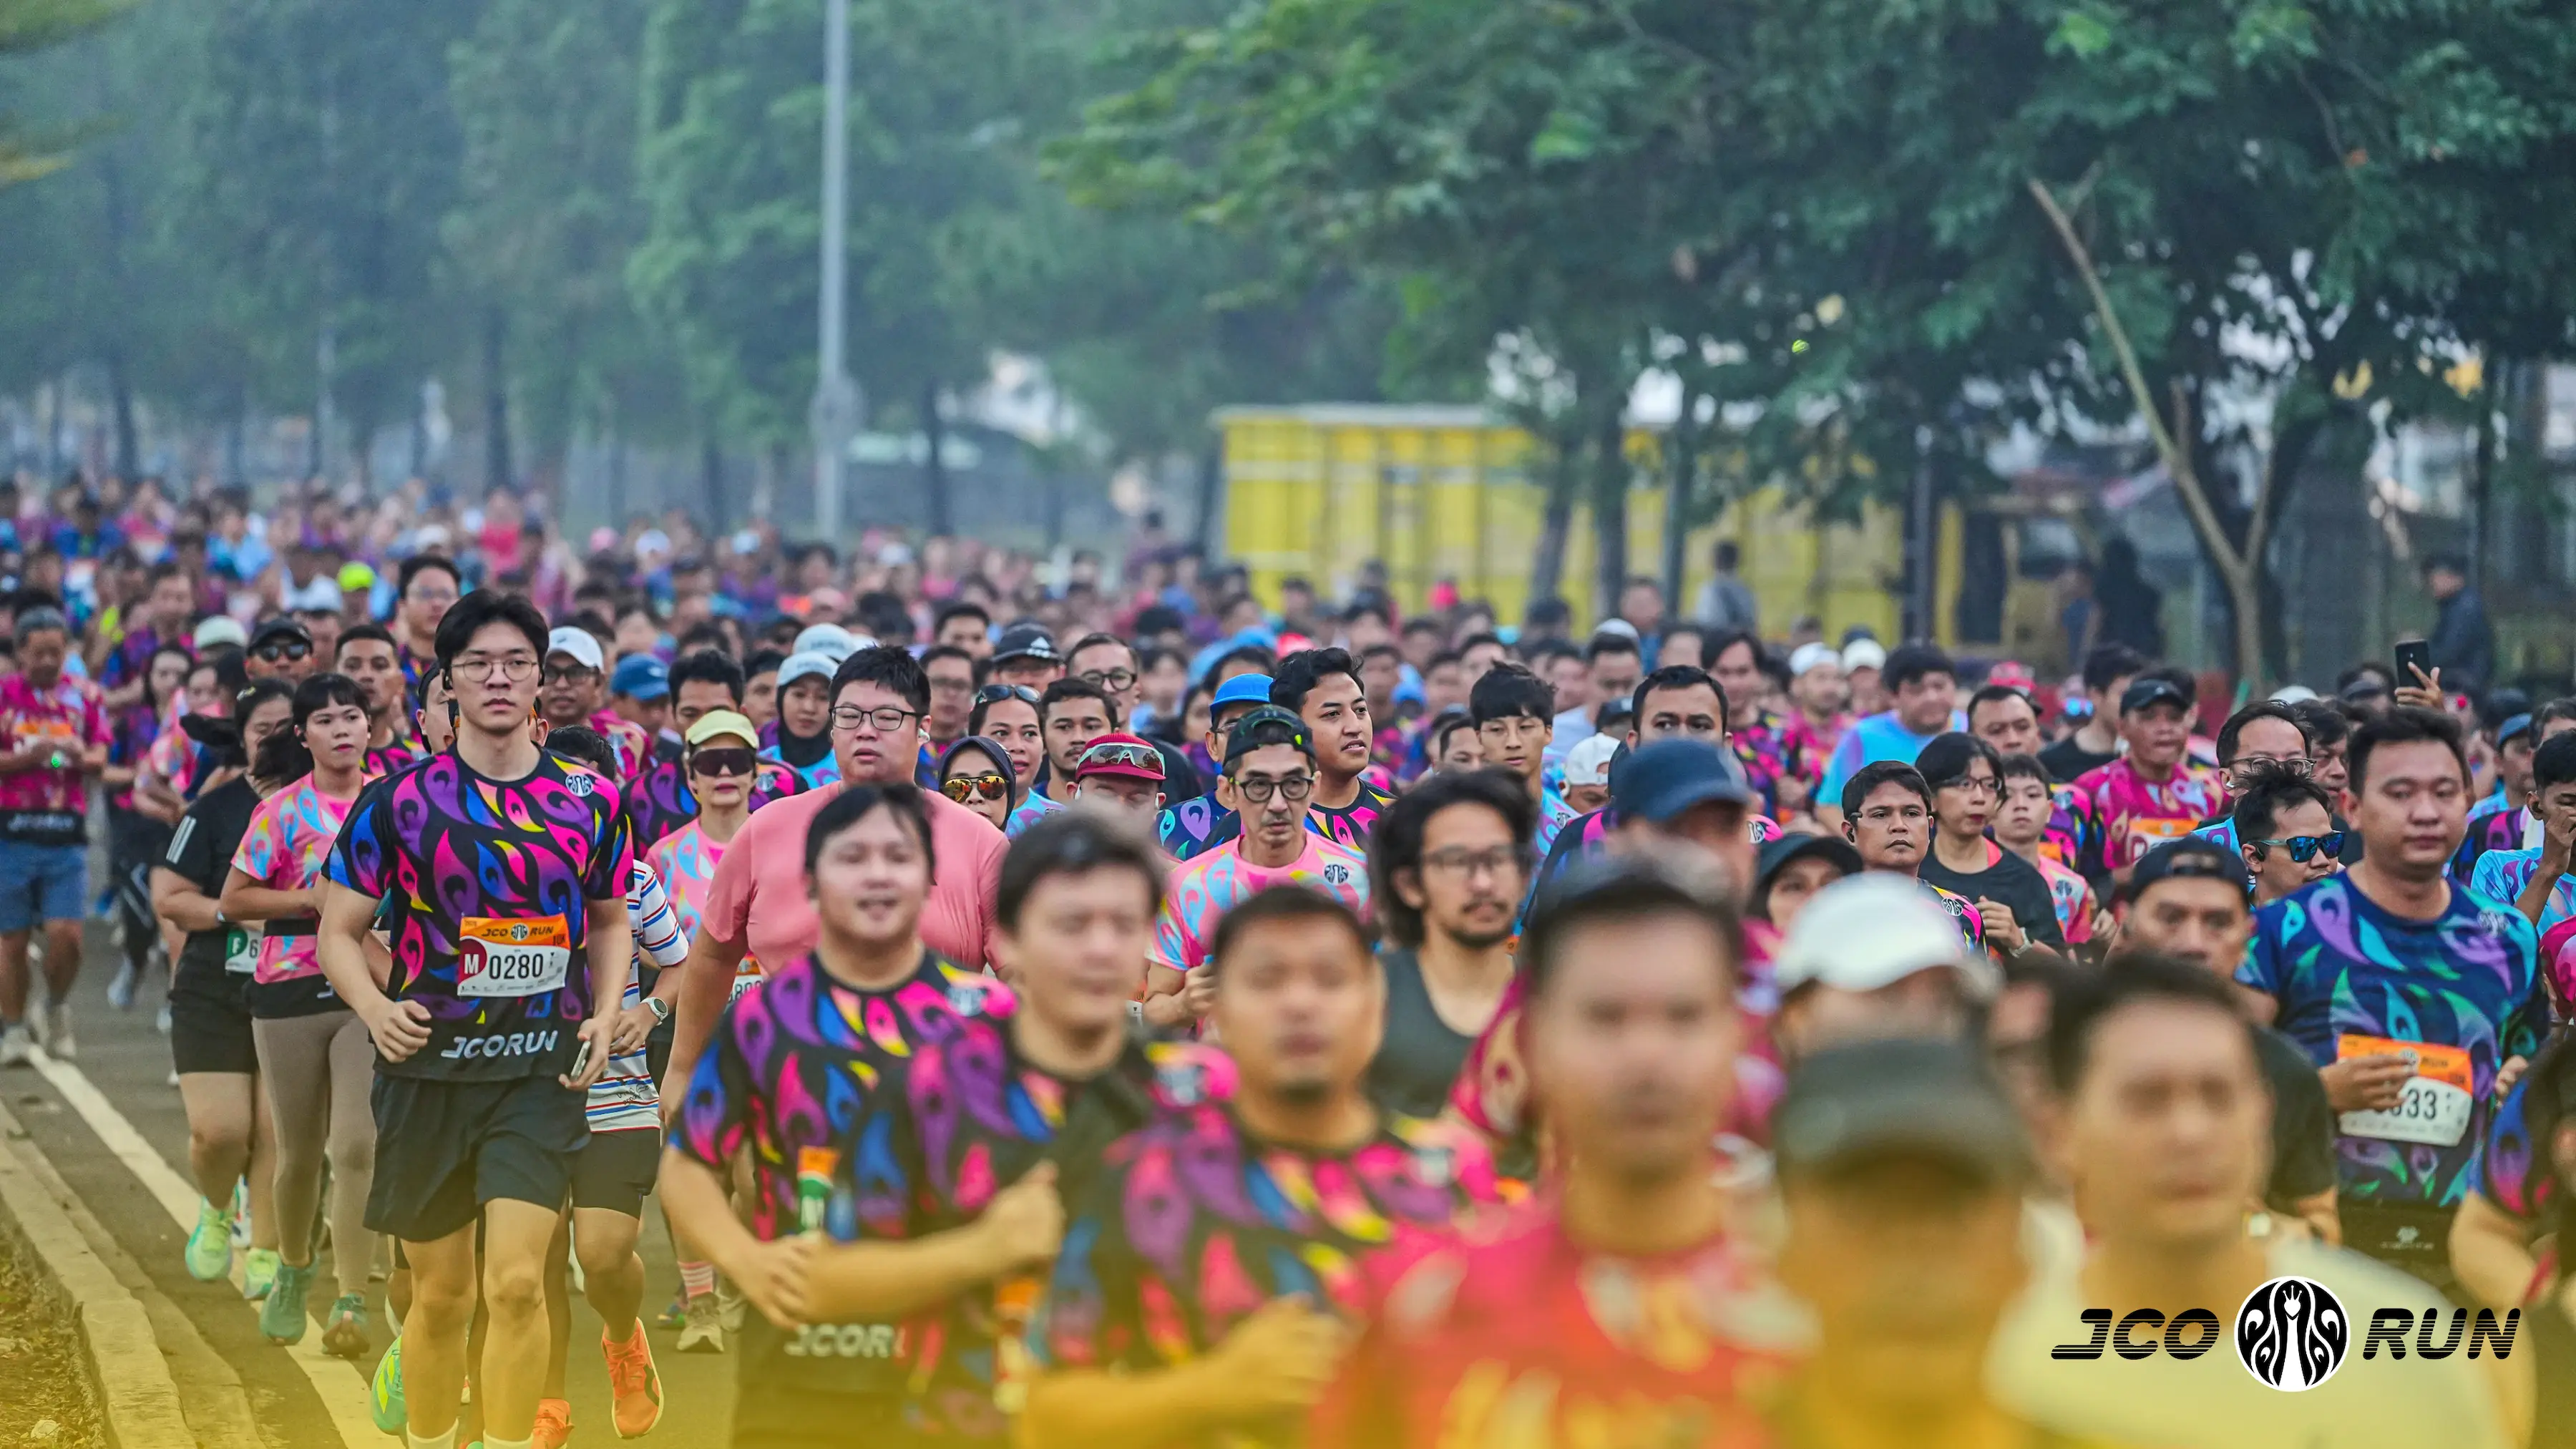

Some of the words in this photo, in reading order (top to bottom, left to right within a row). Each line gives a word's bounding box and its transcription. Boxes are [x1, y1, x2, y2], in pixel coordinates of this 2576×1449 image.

[481, 928, 509, 937] JCO
[530, 926, 554, 936] RUN
[464, 953, 479, 974] M
[489, 952, 544, 980] 0280
[441, 1030, 558, 1059] JCORUN
